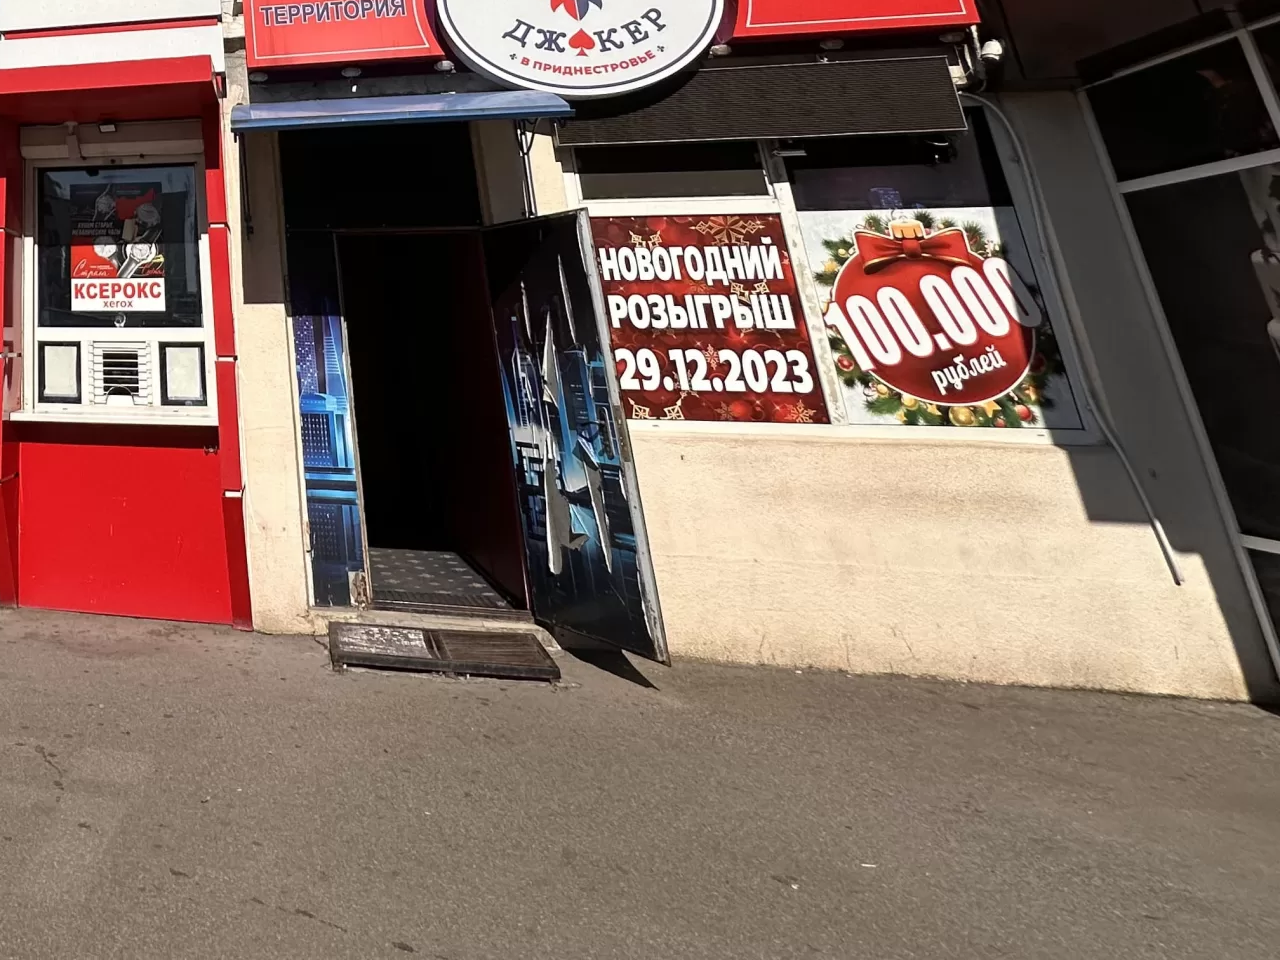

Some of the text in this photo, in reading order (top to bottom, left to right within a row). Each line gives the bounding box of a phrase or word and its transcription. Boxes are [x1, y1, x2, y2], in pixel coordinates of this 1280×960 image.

[502, 7, 667, 57] ДЖКЕР
[520, 49, 656, 76] В ПРИДНЕСТРОВЬЕ
[599, 236, 784, 286] НОВОГОДНИЙ
[74, 282, 161, 299] КСЕРОКС
[610, 293, 795, 330] РОЗЫГРЫШ
[824, 257, 1042, 372] 100.000
[615, 347, 814, 394] 29.12.2023
[932, 345, 1006, 395] рублей
